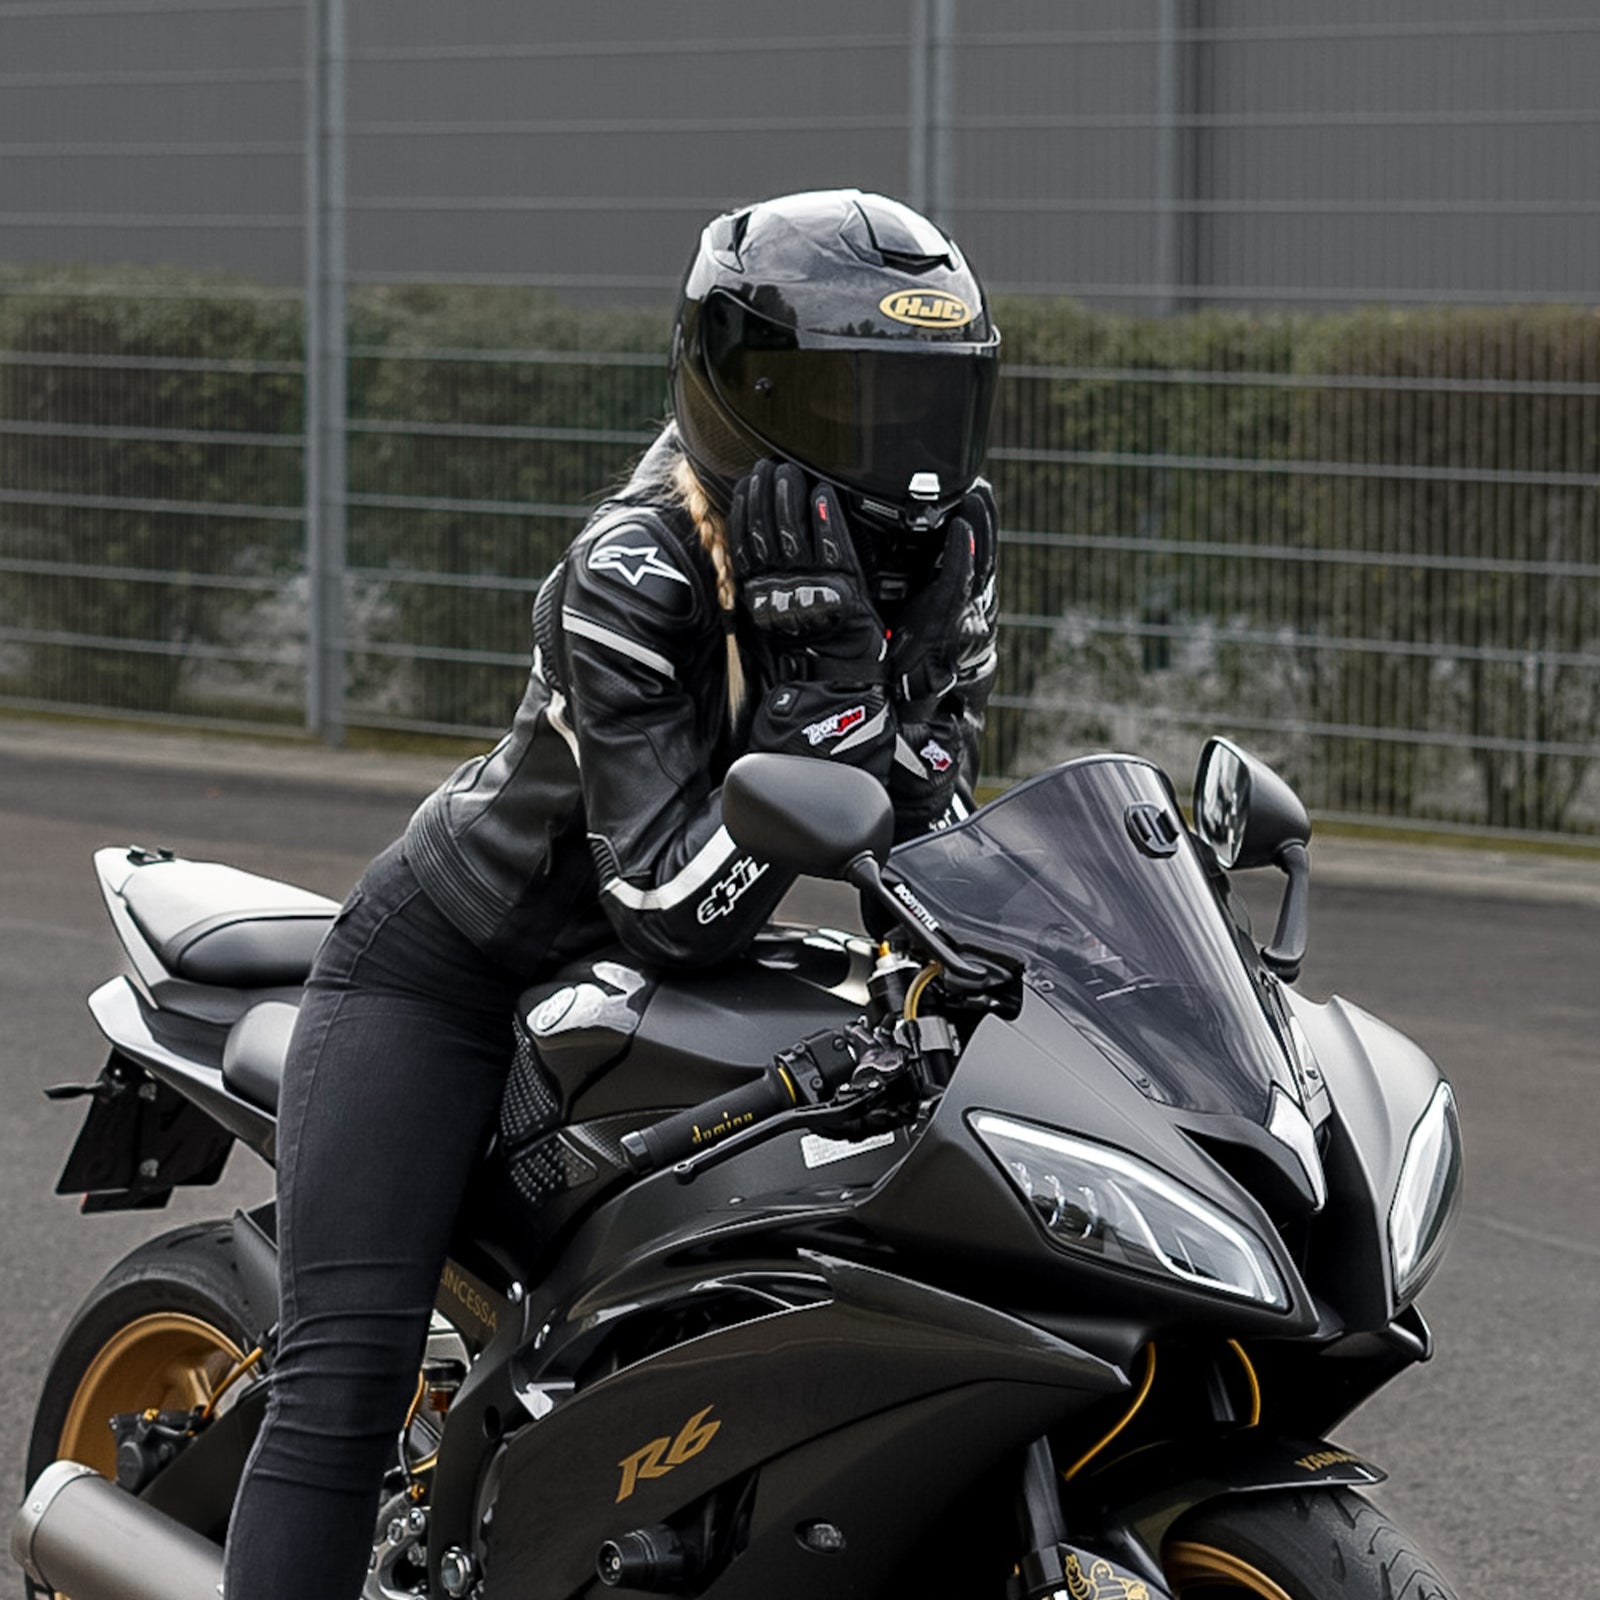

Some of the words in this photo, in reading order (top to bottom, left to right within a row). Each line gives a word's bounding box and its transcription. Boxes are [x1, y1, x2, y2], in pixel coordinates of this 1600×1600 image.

[894, 296, 965, 320] HJC
[441, 1265, 498, 1332] INCESSA
[615, 1404, 722, 1504] R6
